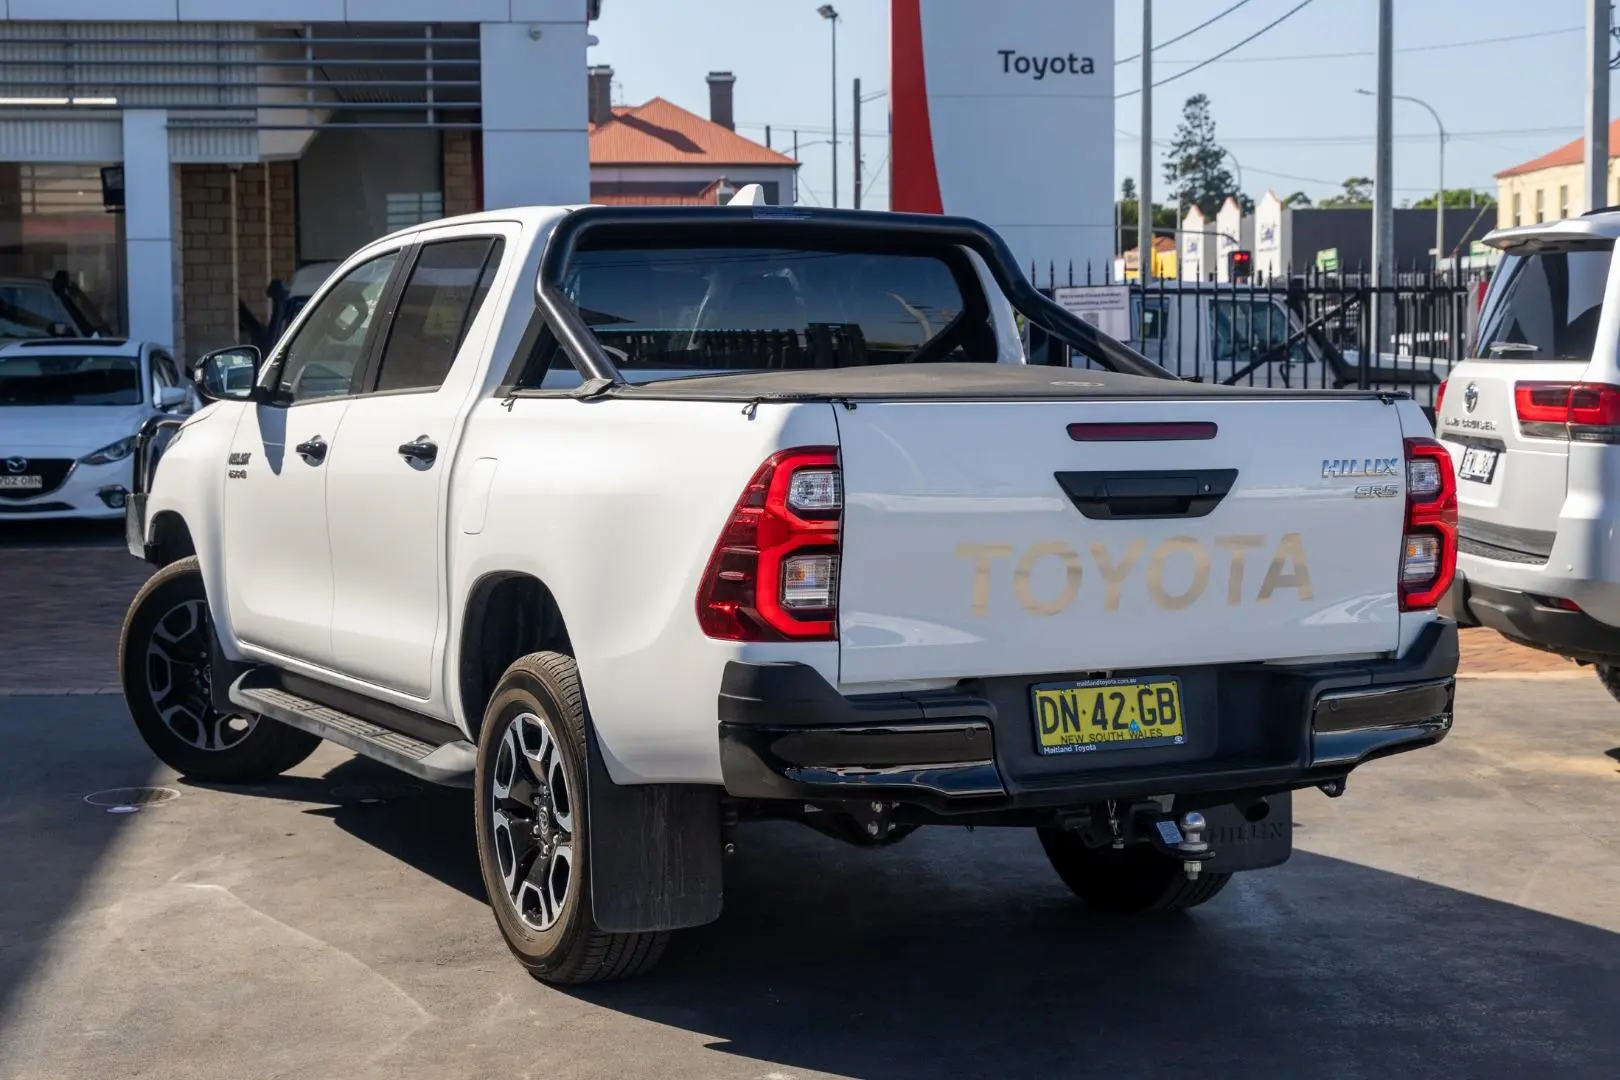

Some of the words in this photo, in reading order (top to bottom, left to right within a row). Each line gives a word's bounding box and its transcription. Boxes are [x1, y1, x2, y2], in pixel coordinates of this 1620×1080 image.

[997, 50, 1095, 80] Toyota
[1321, 458, 1399, 478] HILUX
[1354, 484, 1400, 499] SR5
[955, 532, 1314, 617] TOYOTA
[1060, 734, 1084, 745] NEW
[1089, 731, 1124, 743] SOUTH
[1129, 728, 1163, 740] WALES
[1043, 745, 1073, 755] Maitland
[1074, 743, 1097, 753] Toyota
